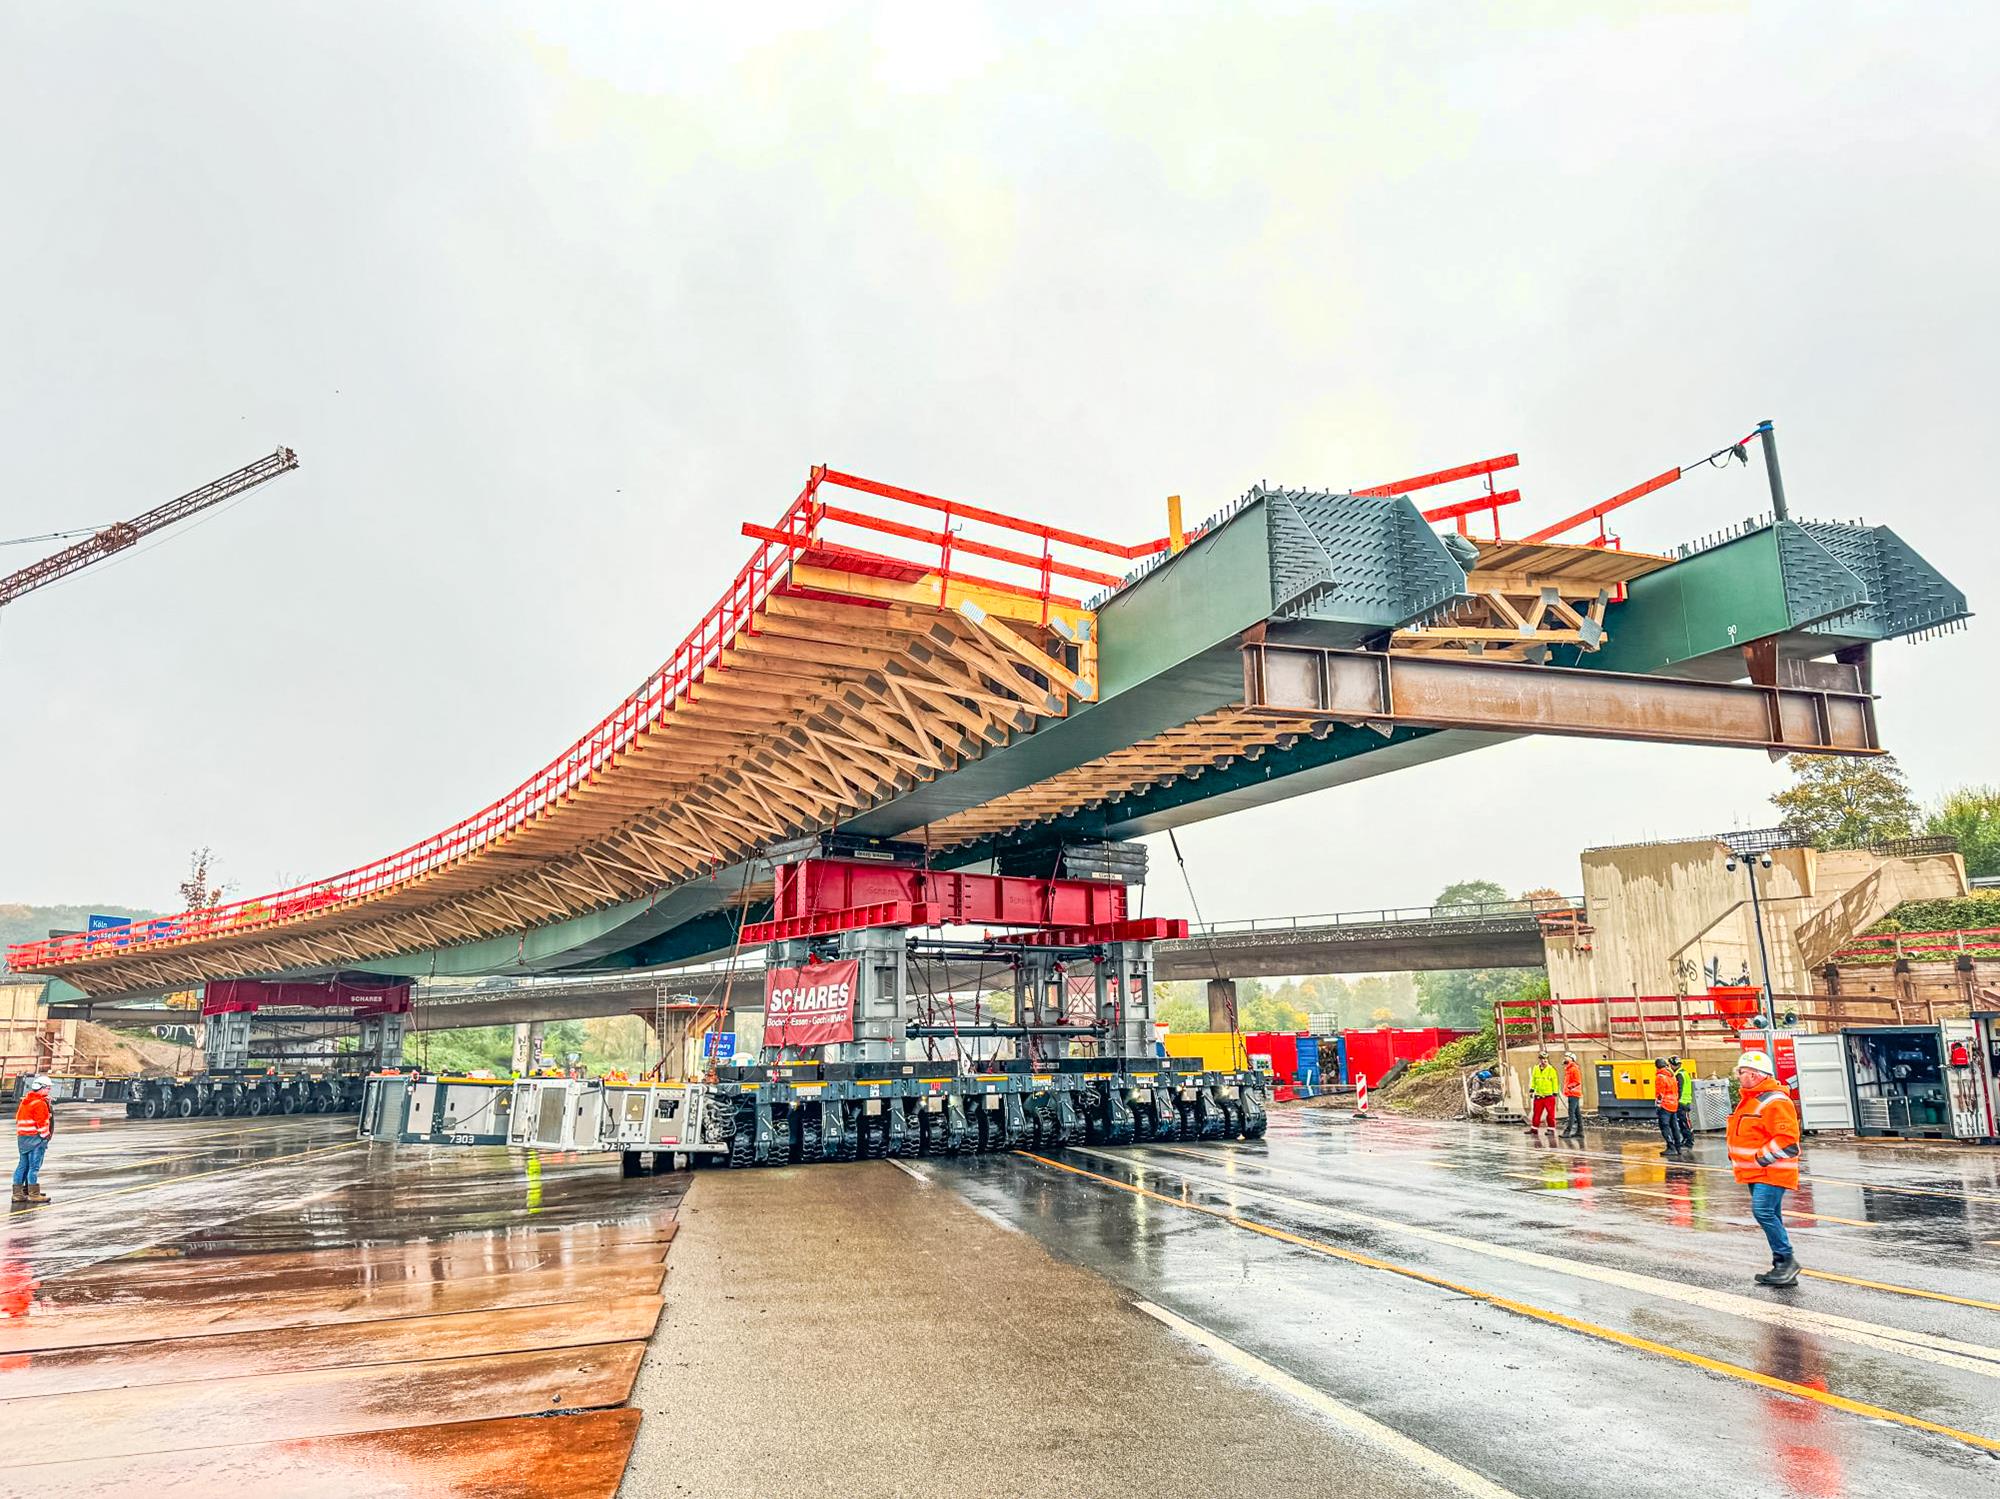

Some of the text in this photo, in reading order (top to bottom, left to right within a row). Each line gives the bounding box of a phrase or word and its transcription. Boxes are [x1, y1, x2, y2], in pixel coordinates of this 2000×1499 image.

[1727, 624, 1737, 635] 90
[92, 919, 108, 929] Köln
[770, 982, 850, 1012] SCHARES
[956, 1120, 963, 1128] 3
[1013, 1117, 1020, 1125] 2
[830, 1127, 838, 1136] 5
[894, 1123, 901, 1131] 4
[449, 1134, 475, 1144] 7303
[761, 1131, 769, 1141] 6
[607, 1142, 631, 1152] 7302
